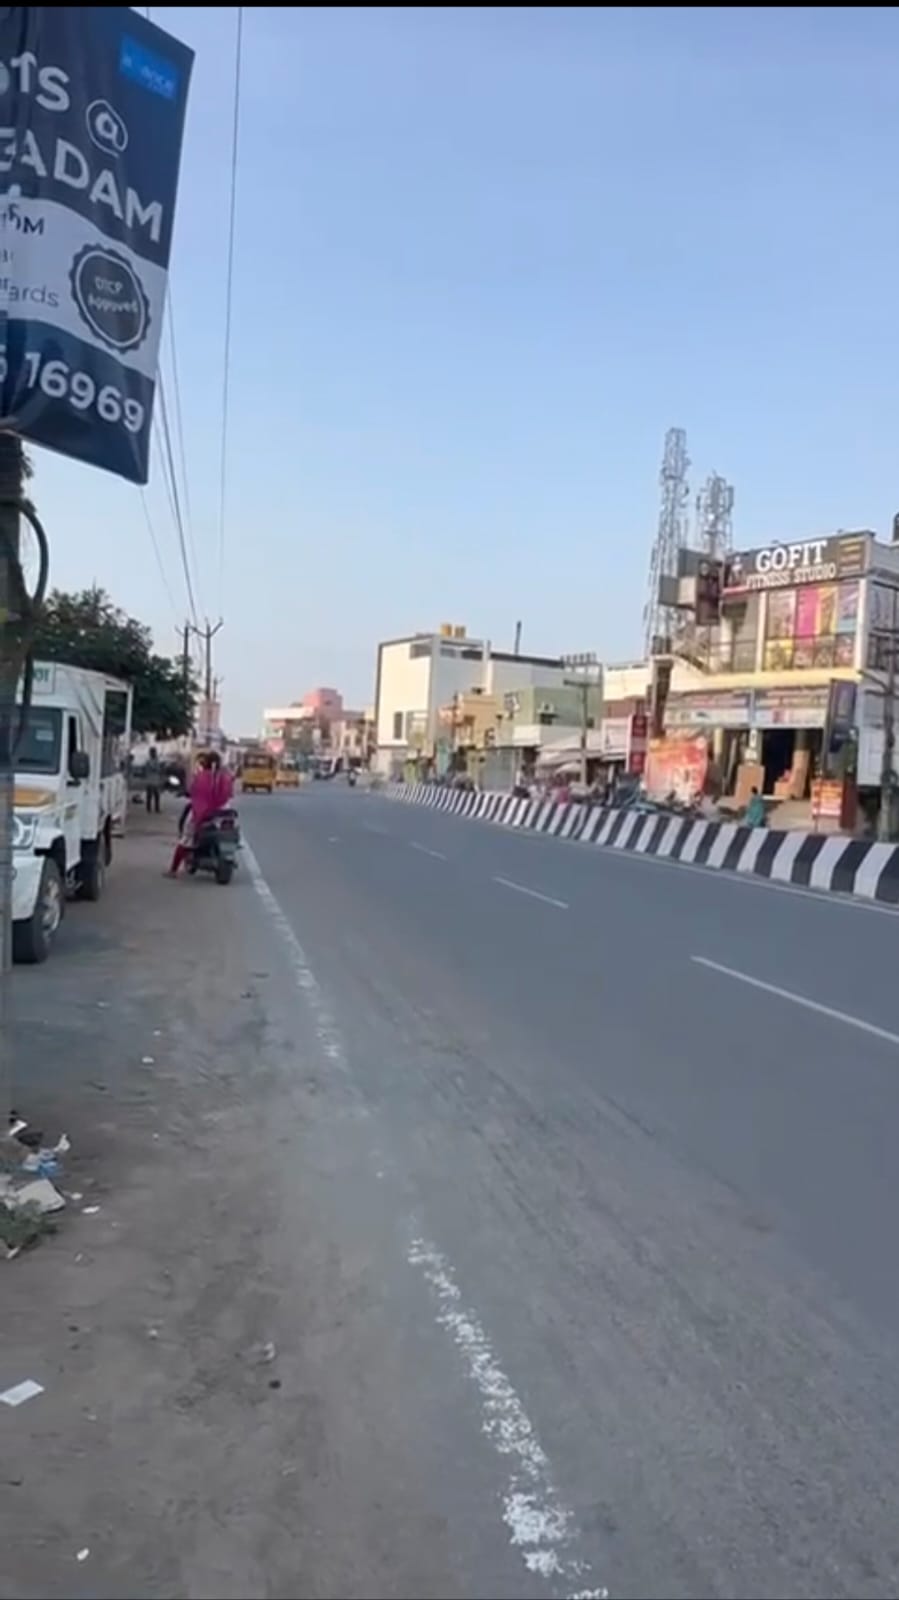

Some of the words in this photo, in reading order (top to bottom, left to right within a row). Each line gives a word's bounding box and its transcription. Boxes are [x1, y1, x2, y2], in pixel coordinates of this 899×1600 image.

[86, 99, 129, 158] @
[24, 351, 145, 433] 16969
[746, 570, 791, 590] FITNESS
[793, 562, 837, 584] STUDIO
[756, 540, 828, 573] GOFIT
